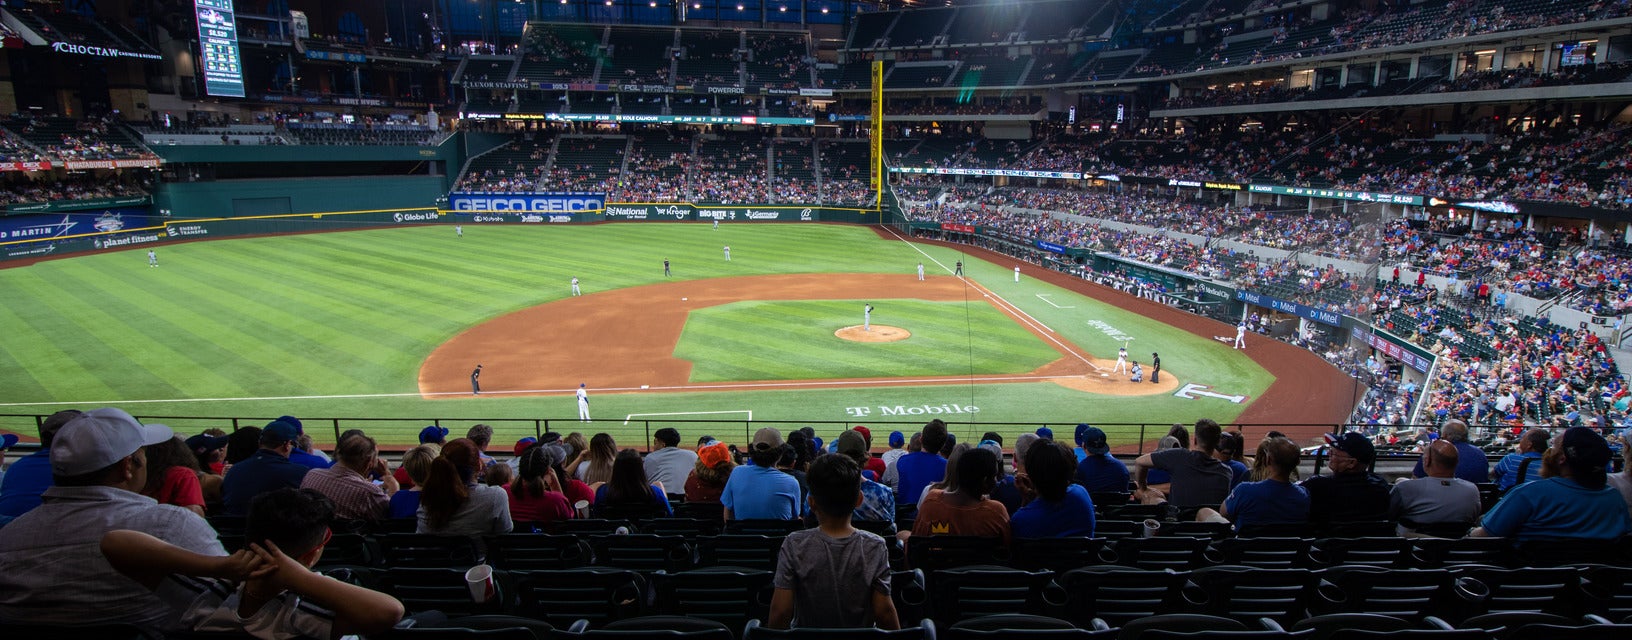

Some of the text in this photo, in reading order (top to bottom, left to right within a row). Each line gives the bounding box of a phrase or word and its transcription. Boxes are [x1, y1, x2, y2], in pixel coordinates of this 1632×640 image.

[59, 41, 119, 57] CHOCTAW
[708, 86, 744, 94] POWERADE
[454, 198, 602, 211] GEICO GEICO
[404, 212, 439, 221] Globe Life
[615, 208, 648, 216] National
[666, 205, 691, 219] Kroger
[12, 227, 52, 238] MARTIN
[103, 233, 159, 249] planet fitness
[1244, 293, 1260, 304] Mitel
[1279, 303, 1296, 313] Mitel
[1319, 311, 1338, 324] Mitel
[878, 403, 980, 417] Mobile
